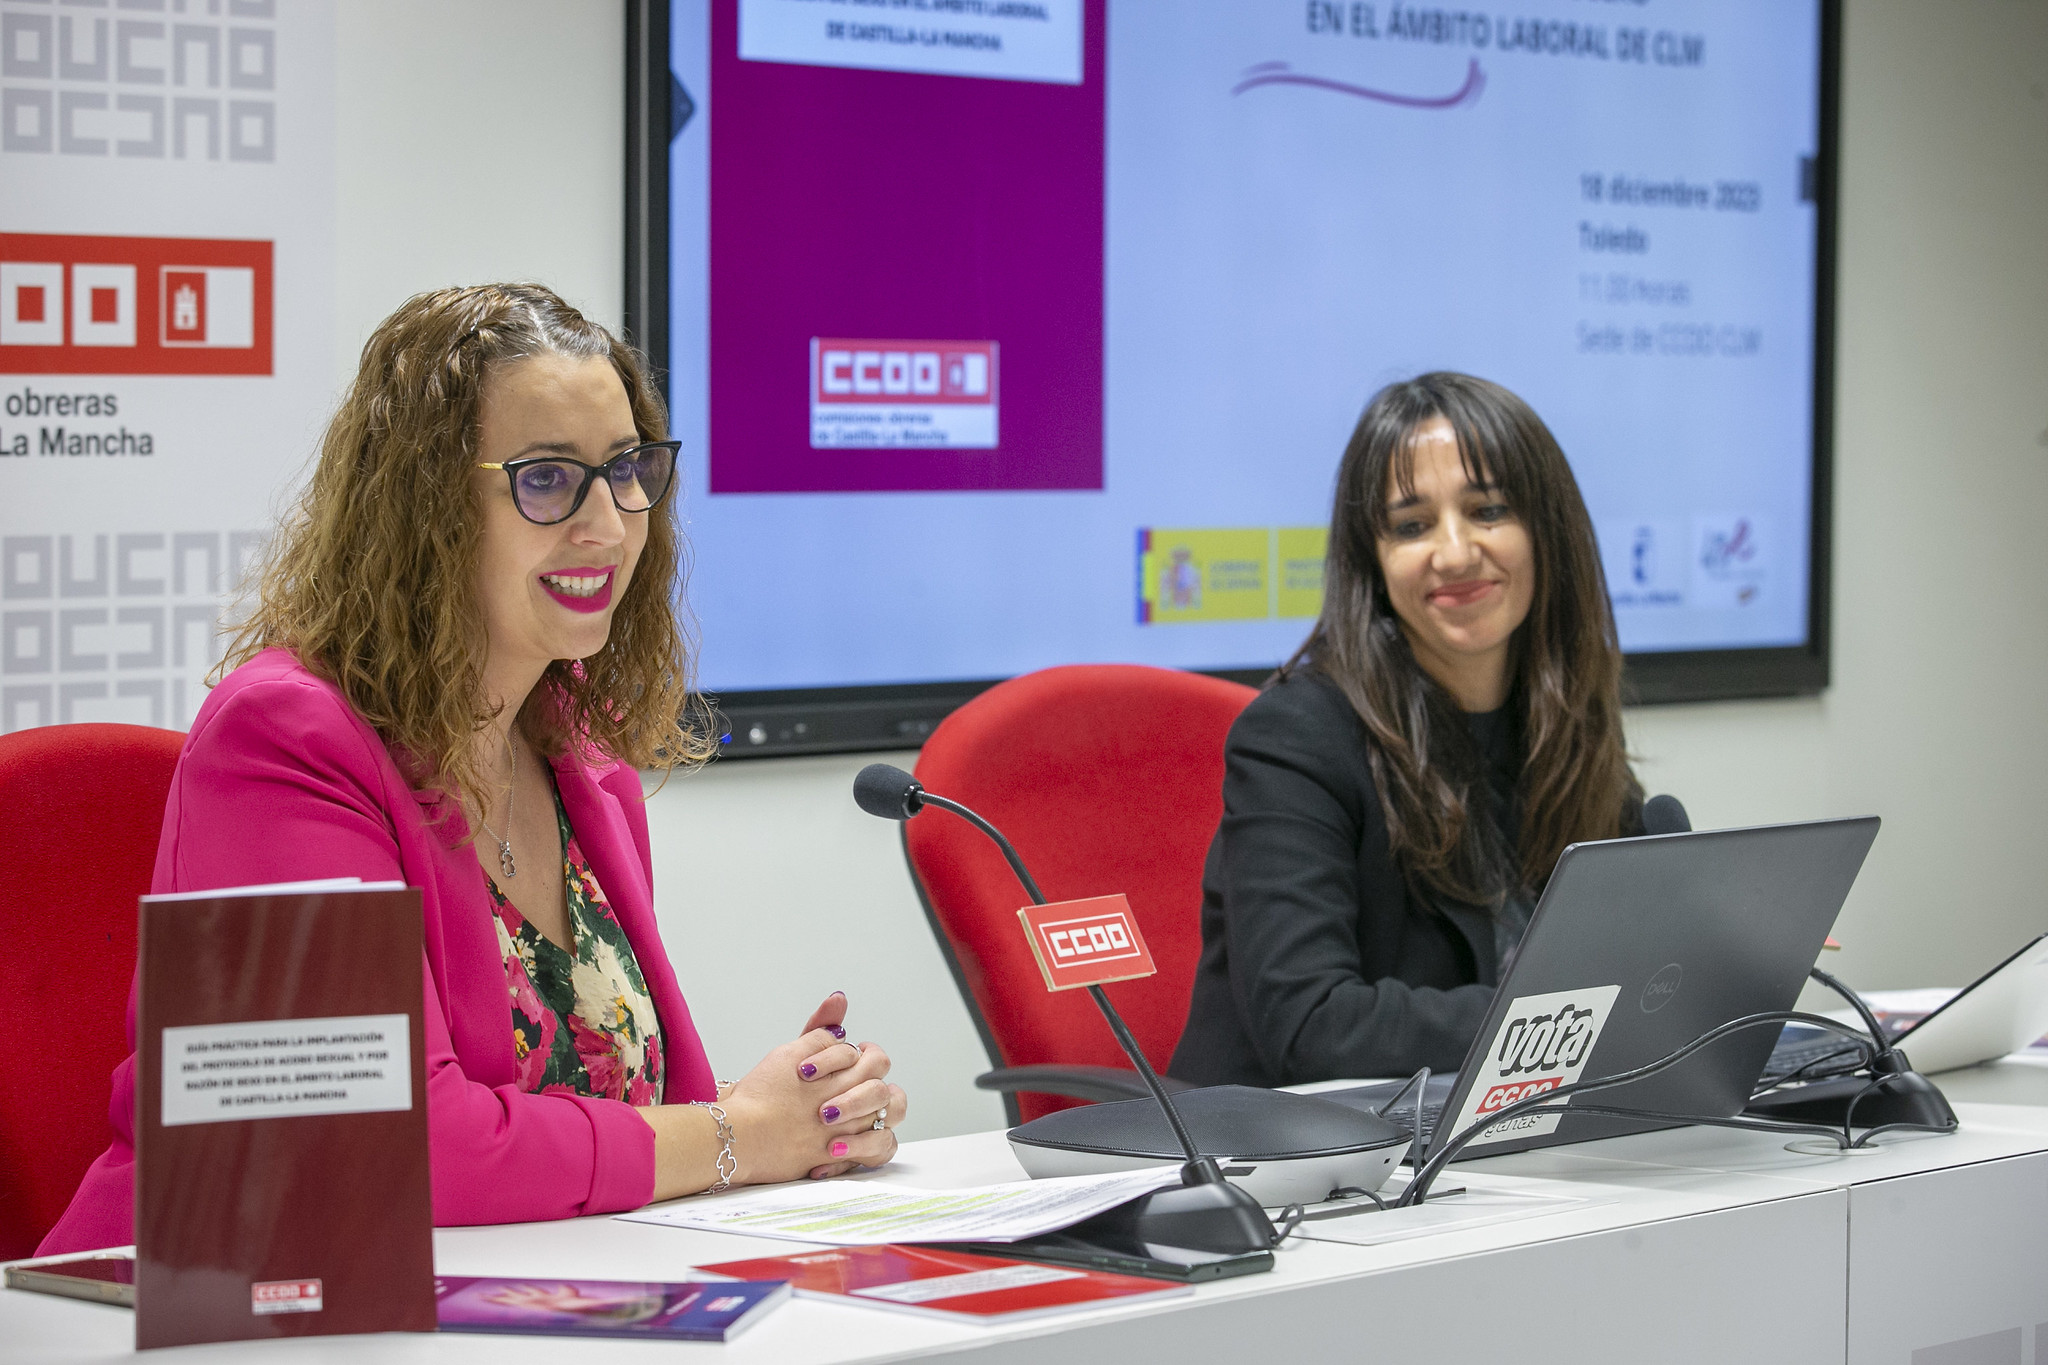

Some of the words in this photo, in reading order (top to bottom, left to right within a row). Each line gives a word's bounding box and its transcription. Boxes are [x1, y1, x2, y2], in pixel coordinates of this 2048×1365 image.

[826, 21, 845, 40] DE
[1306, 0, 1342, 34] EN
[1349, 1, 1379, 39] EL
[1495, 18, 1608, 60] LABORAL
[1615, 27, 1645, 64] DE
[1651, 30, 1705, 67] CLM
[1608, 173, 1709, 207] diciembre
[1579, 220, 1648, 252] Toledo
[822, 350, 941, 395] CCOO
[6, 386, 117, 417] obreras
[40, 426, 154, 456] Mancha
[1049, 922, 1131, 958] CCOO
[307, 1031, 384, 1045] IMPLANTACIÓN
[203, 1058, 259, 1070] PROTOCOLO
[316, 1052, 354, 1063] SEXUAL
[337, 1068, 383, 1080] LABORAL
[257, 1284, 299, 1300] CCOO
